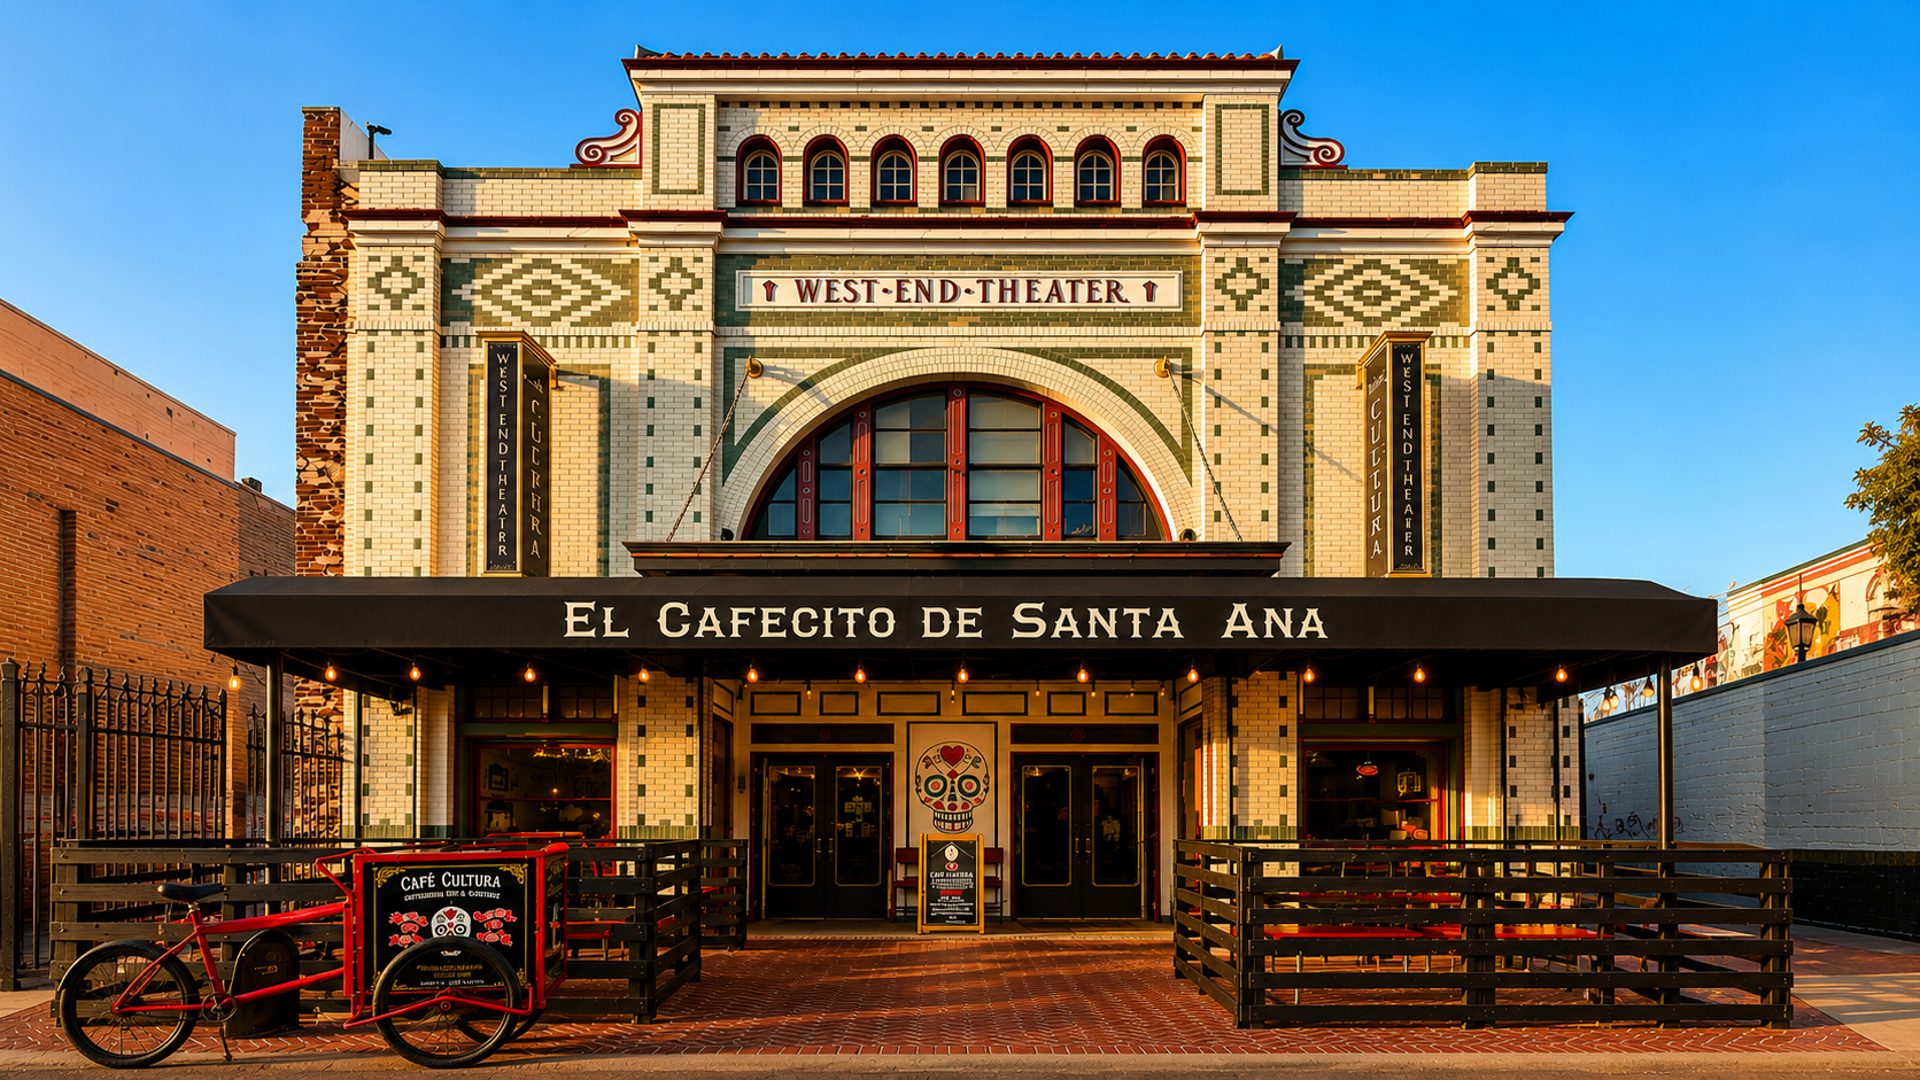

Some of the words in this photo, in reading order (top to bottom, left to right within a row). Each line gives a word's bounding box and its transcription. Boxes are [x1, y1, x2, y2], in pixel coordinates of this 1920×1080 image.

[496, 353, 510, 408] WEST
[1400, 353, 1414, 408] WEST
[564, 600, 630, 638] EL
[657, 601, 896, 638] CAFECITO
[921, 606, 983, 638] DE
[1011, 601, 1185, 639] SANTA
[1220, 602, 1329, 639] ANA
[401, 872, 436, 891] CAFÉ
[441, 871, 501, 888] CULTURA
